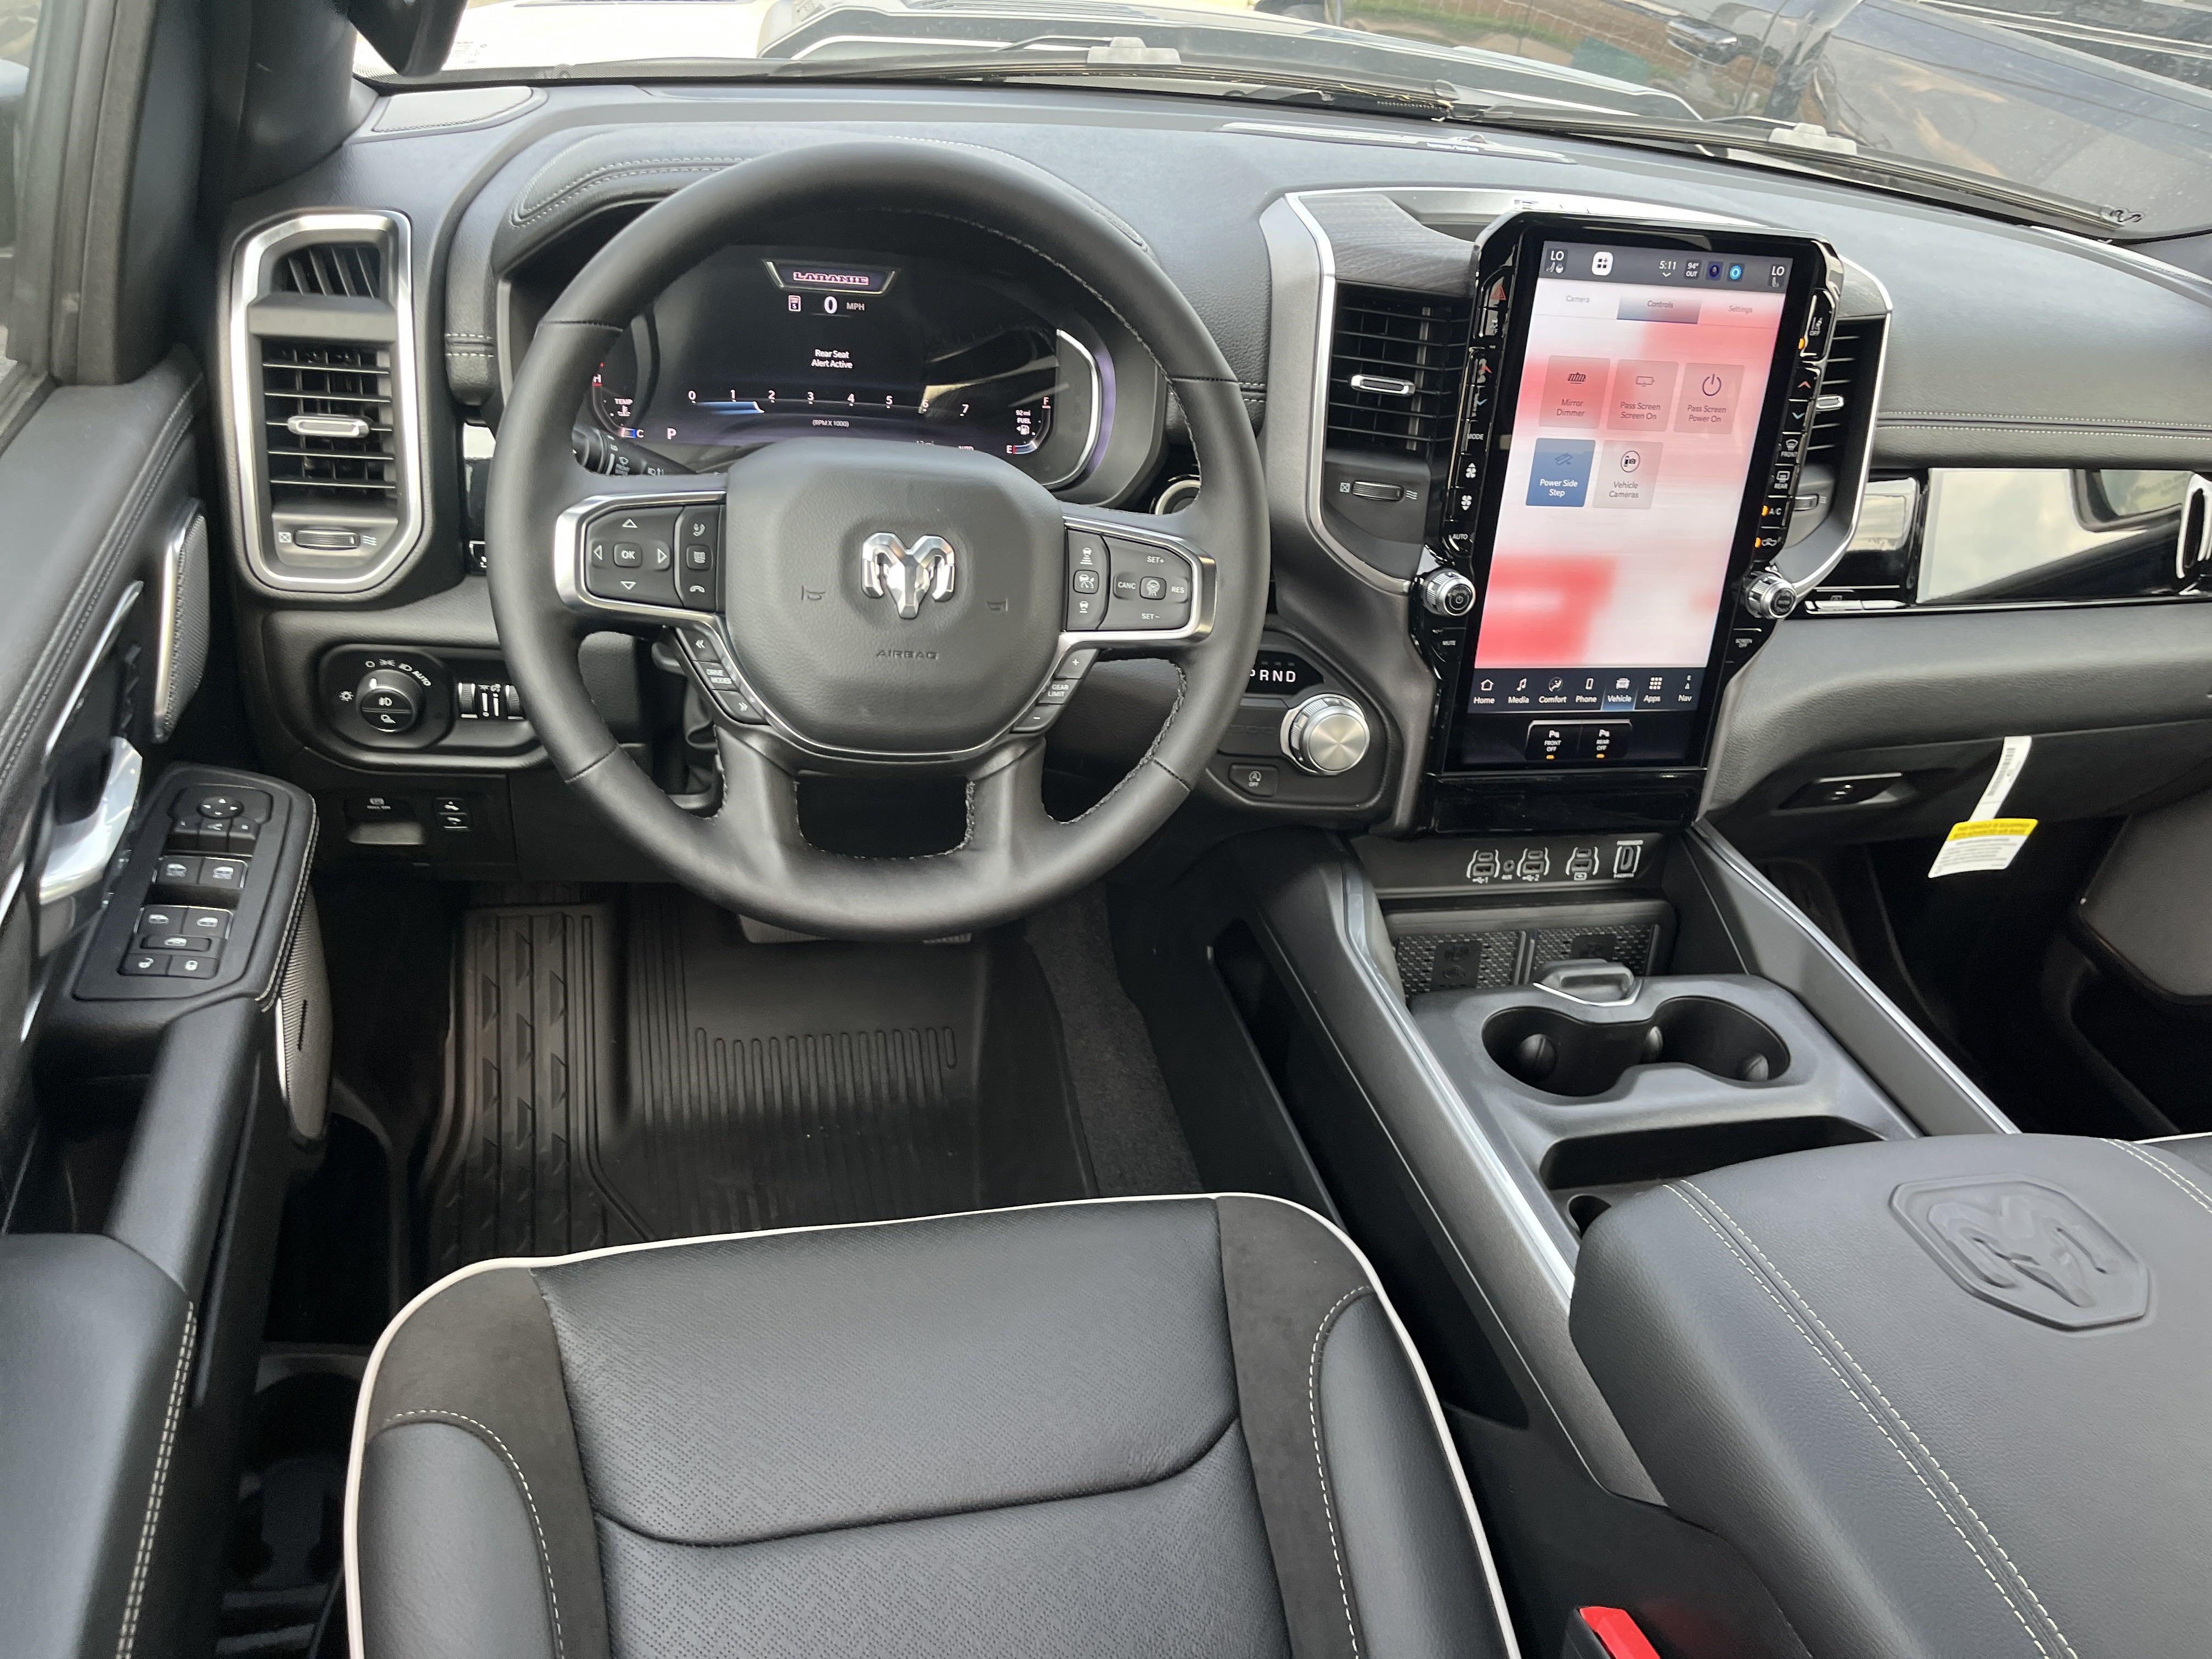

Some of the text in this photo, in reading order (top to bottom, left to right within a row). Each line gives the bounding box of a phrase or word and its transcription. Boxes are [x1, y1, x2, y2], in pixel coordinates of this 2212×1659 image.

[1550, 250, 1565, 261] LO
[1658, 260, 1677, 270] 5:11
[1771, 266, 1785, 276] LO
[793, 271, 870, 286] LARAMIE
[1565, 294, 1590, 304] Camera
[823, 296, 865, 314] 0 MPH
[1647, 300, 1674, 309] Controls
[1729, 304, 1753, 314] Settings
[815, 348, 850, 359] Rear Seat
[811, 359, 853, 369] Alert Active
[688, 389, 969, 413] 0 1 2 3 4 5 6 7
[1043, 397, 1049, 405] F
[1561, 398, 1584, 407] Mirror
[1620, 402, 1661, 411] Pass Screen
[1687, 404, 1726, 414] Pass Screen
[1556, 408, 1585, 417] Dimmer
[1620, 411, 1657, 420] Screen On
[1688, 415, 1710, 423] Power
[636, 428, 645, 438] C
[667, 427, 677, 440] P
[1006, 445, 1013, 454] E
[1539, 478, 1578, 487] Power Side
[1613, 481, 1639, 489] Vehicle
[1548, 488, 1565, 498] Step
[1609, 490, 1639, 499] Cameras
[1768, 507, 1782, 516] A/C
[621, 550, 636, 559] OK
[1147, 555, 1165, 564] SET+
[1118, 581, 1136, 590] CANC
[1171, 586, 1186, 594] RES
[876, 648, 939, 659] AIRBAG
[411, 670, 432, 686] AUTO
[1473, 696, 1496, 704] Home
[1507, 695, 1530, 704] Media
[1538, 695, 1567, 704] Comfort
[1575, 695, 1597, 703] Phone
[1607, 695, 1632, 703] Vehicle
[1643, 695, 1661, 704] Apps
